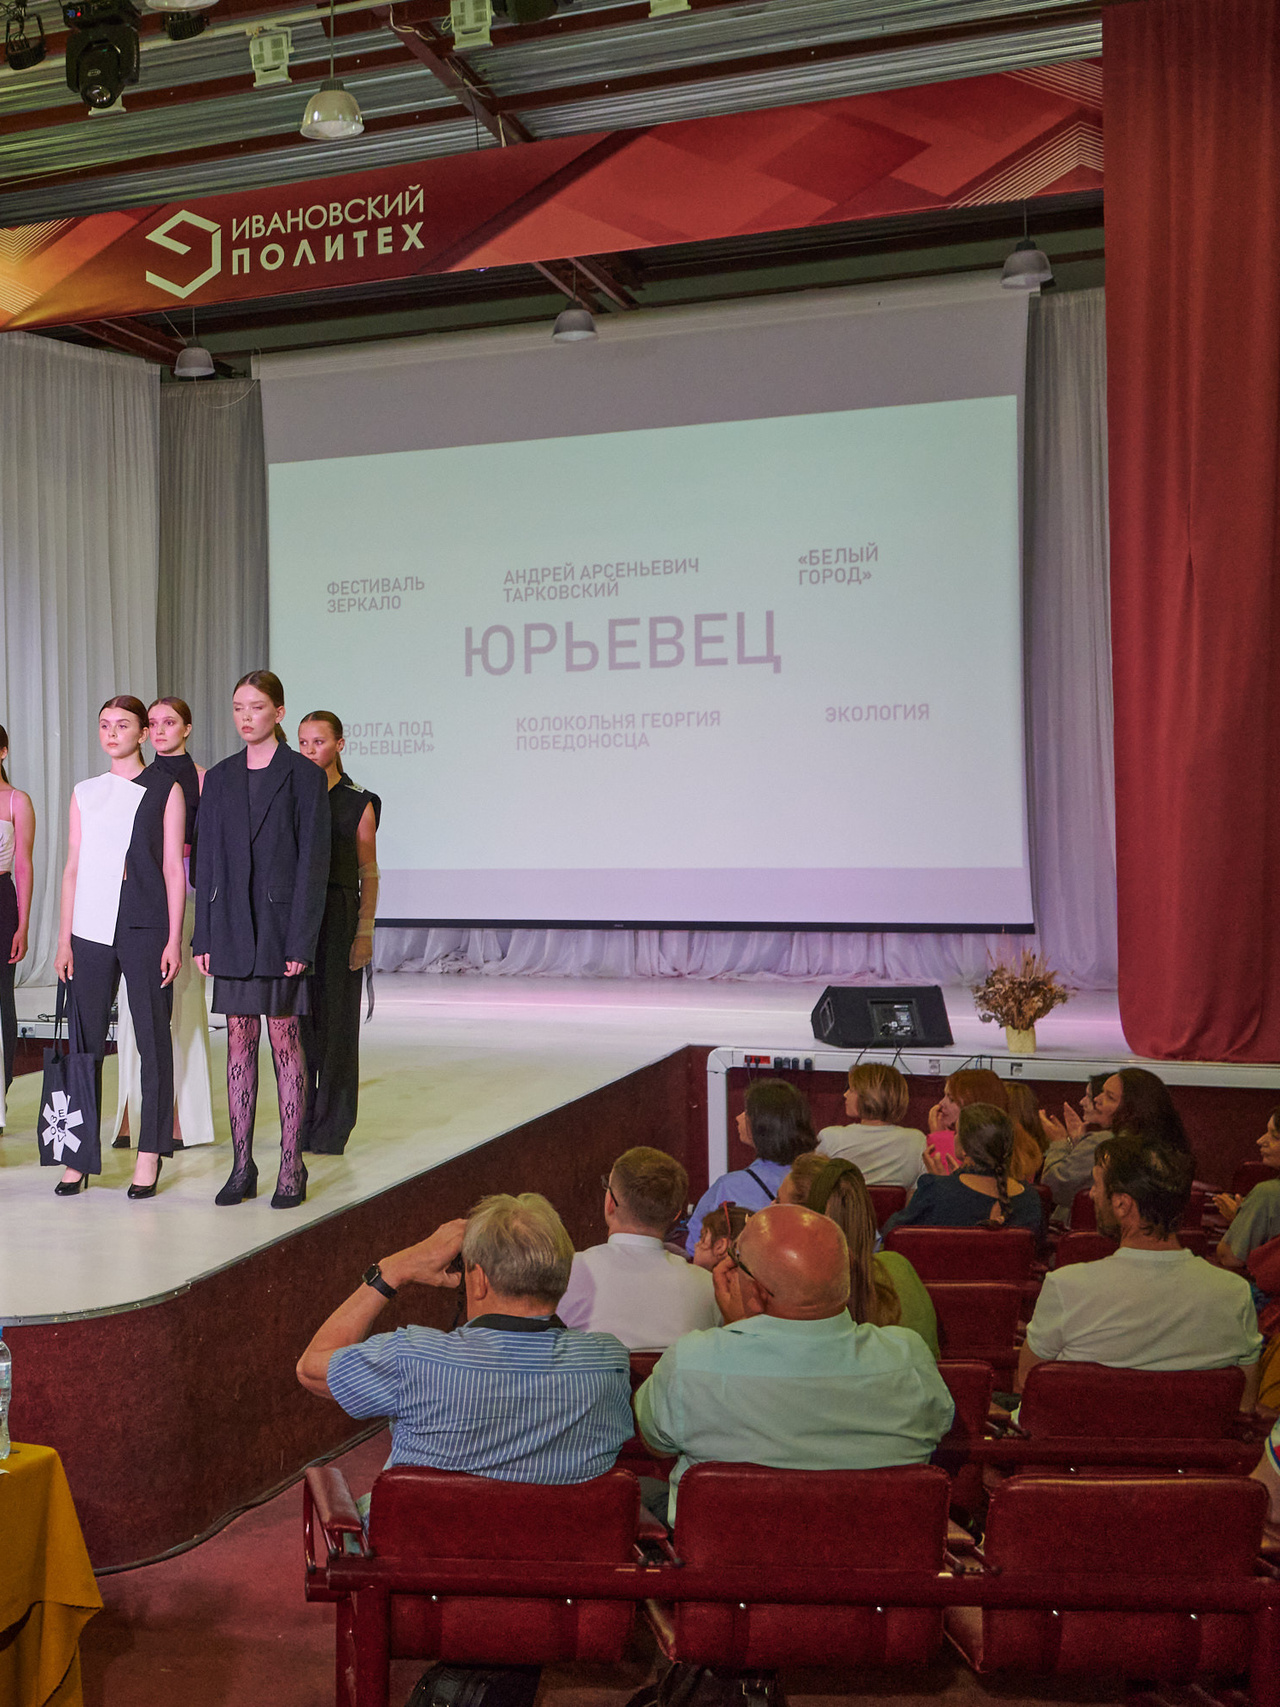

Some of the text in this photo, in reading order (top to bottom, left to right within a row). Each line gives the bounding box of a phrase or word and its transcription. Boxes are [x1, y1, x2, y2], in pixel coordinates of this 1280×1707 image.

[232, 184, 424, 241] ИВАНОВСКИЙ
[232, 222, 425, 276] ПОЛИТЕХ
[797, 542, 879, 566] «БЕЛЫЙ
[503, 557, 699, 586] АНДРЕЙ АРСЕНЬЕВИЧ
[798, 566, 873, 586] ГОРОД»
[326, 576, 425, 596] ФЕСТИВАЛЬ
[503, 577, 619, 603] ТАРКОВСКИЙ
[326, 596, 402, 614] ЗЕРКАЛО
[464, 610, 782, 677] ЮРЬЕВЕЦ
[516, 710, 721, 733] КОЛОКОЛЬНЯ ГЕОРГИЯ
[824, 703, 930, 723] ЭКОЛОГИЯ
[342, 720, 434, 738] ВОЛГА ПОД
[516, 731, 650, 752] ПОБЕДОНОСЦА
